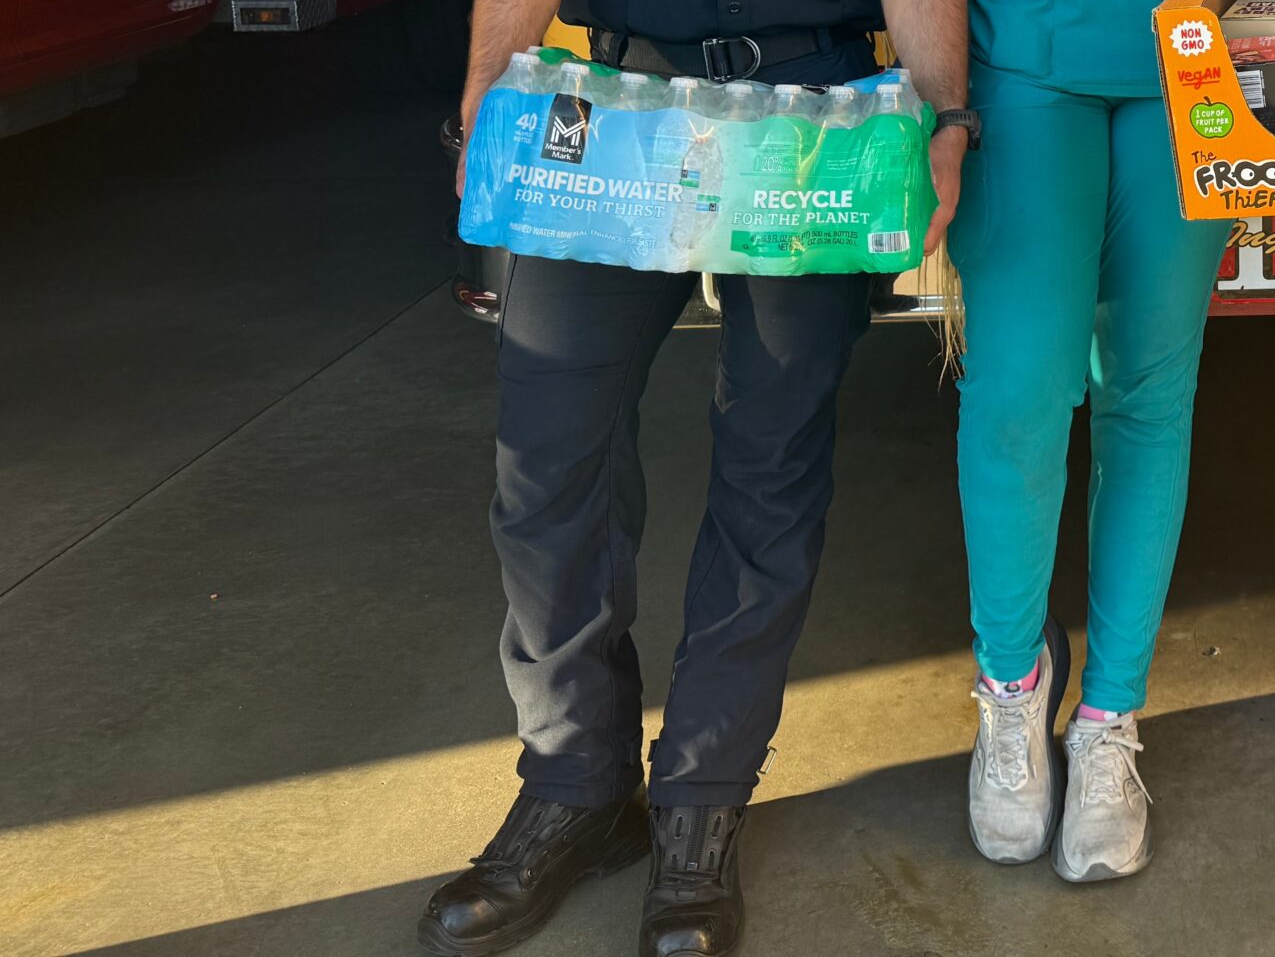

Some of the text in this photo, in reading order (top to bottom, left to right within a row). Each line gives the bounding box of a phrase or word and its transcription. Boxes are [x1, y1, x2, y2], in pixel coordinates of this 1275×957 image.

[1180, 28, 1202, 39] NON
[1181, 39, 1205, 50] GMO
[1196, 109, 1225, 118] 1 CUP OF
[516, 113, 538, 131] 40
[1216, 117, 1229, 125] PER
[1204, 126, 1222, 134] PACK
[545, 143, 582, 155] Member's
[1192, 151, 1217, 164] The
[761, 156, 784, 172] 20%
[507, 164, 683, 203] PURIFIED WATER
[514, 189, 666, 218] FOR YOUR THIRST
[753, 190, 853, 209] RECYCLE
[732, 211, 869, 226] FOR THE PLANET
[533, 226, 555, 238] WATER
[811, 230, 823, 238] 500
[833, 230, 858, 238] BOTTLES
[778, 243, 788, 251] NET
